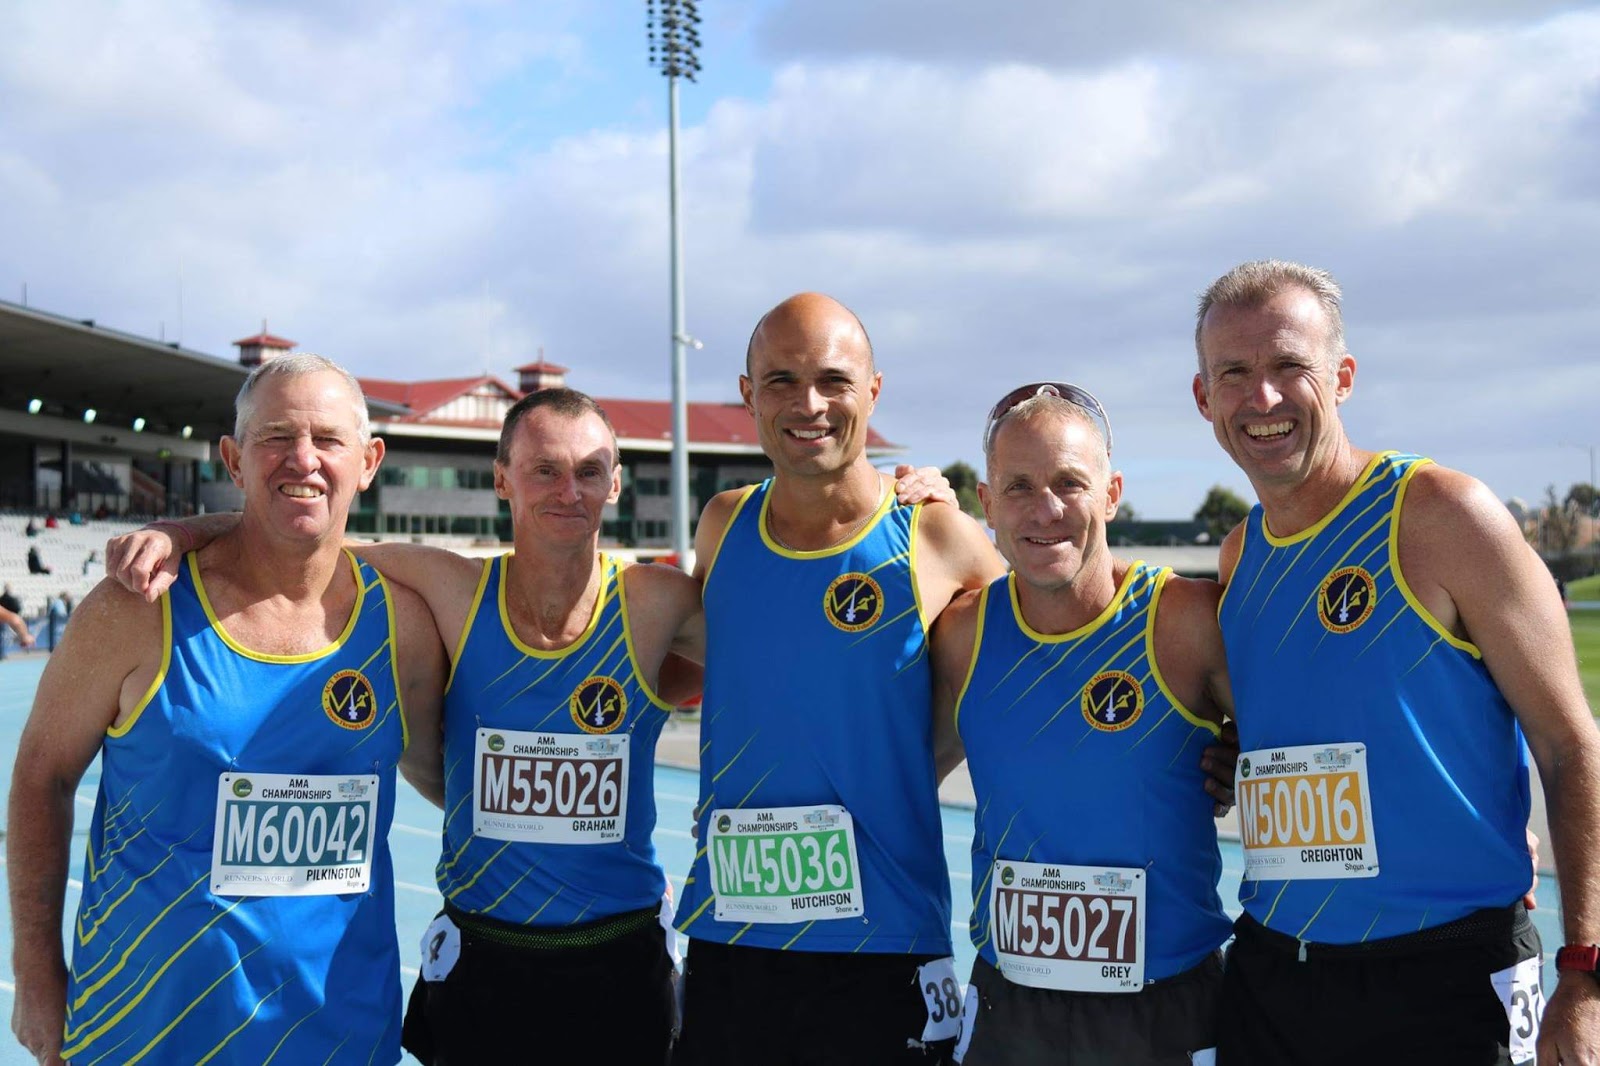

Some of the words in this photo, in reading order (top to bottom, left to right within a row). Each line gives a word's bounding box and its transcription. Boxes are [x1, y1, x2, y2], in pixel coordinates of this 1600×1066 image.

[537, 736, 556, 745] AMA
[513, 745, 579, 757] CHAMPIONSHIPS
[1270, 752, 1286, 763] AMA
[1255, 762, 1308, 776] CHAMPIONSHIPS
[288, 779, 309, 788] AMA
[484, 757, 618, 815] M55026
[262, 789, 332, 800] CHAMPIONSHIPS
[757, 812, 774, 821] AMA
[1241, 776, 1358, 846] M50016
[484, 819, 516, 829] RUNNERS
[517, 823, 544, 831] WORLD
[572, 819, 616, 832] GRAHAM
[737, 822, 798, 833] CHAMPIONSHIPS
[226, 804, 366, 863] M60042
[1301, 847, 1363, 863] CREIGHTON
[717, 834, 848, 894] M45036
[224, 874, 262, 882] RUNNERS
[306, 867, 362, 881] PILKINGTON
[1042, 868, 1061, 878] AMA
[1021, 878, 1086, 892] CHAMPIONSHIPS
[791, 893, 852, 910] HUTCHISON
[1000, 891, 1133, 960] M55027
[1026, 966, 1052, 975] WORLD
[1101, 966, 1131, 978] GREY
[925, 977, 960, 1023] 38
[1511, 984, 1539, 1039] 3
